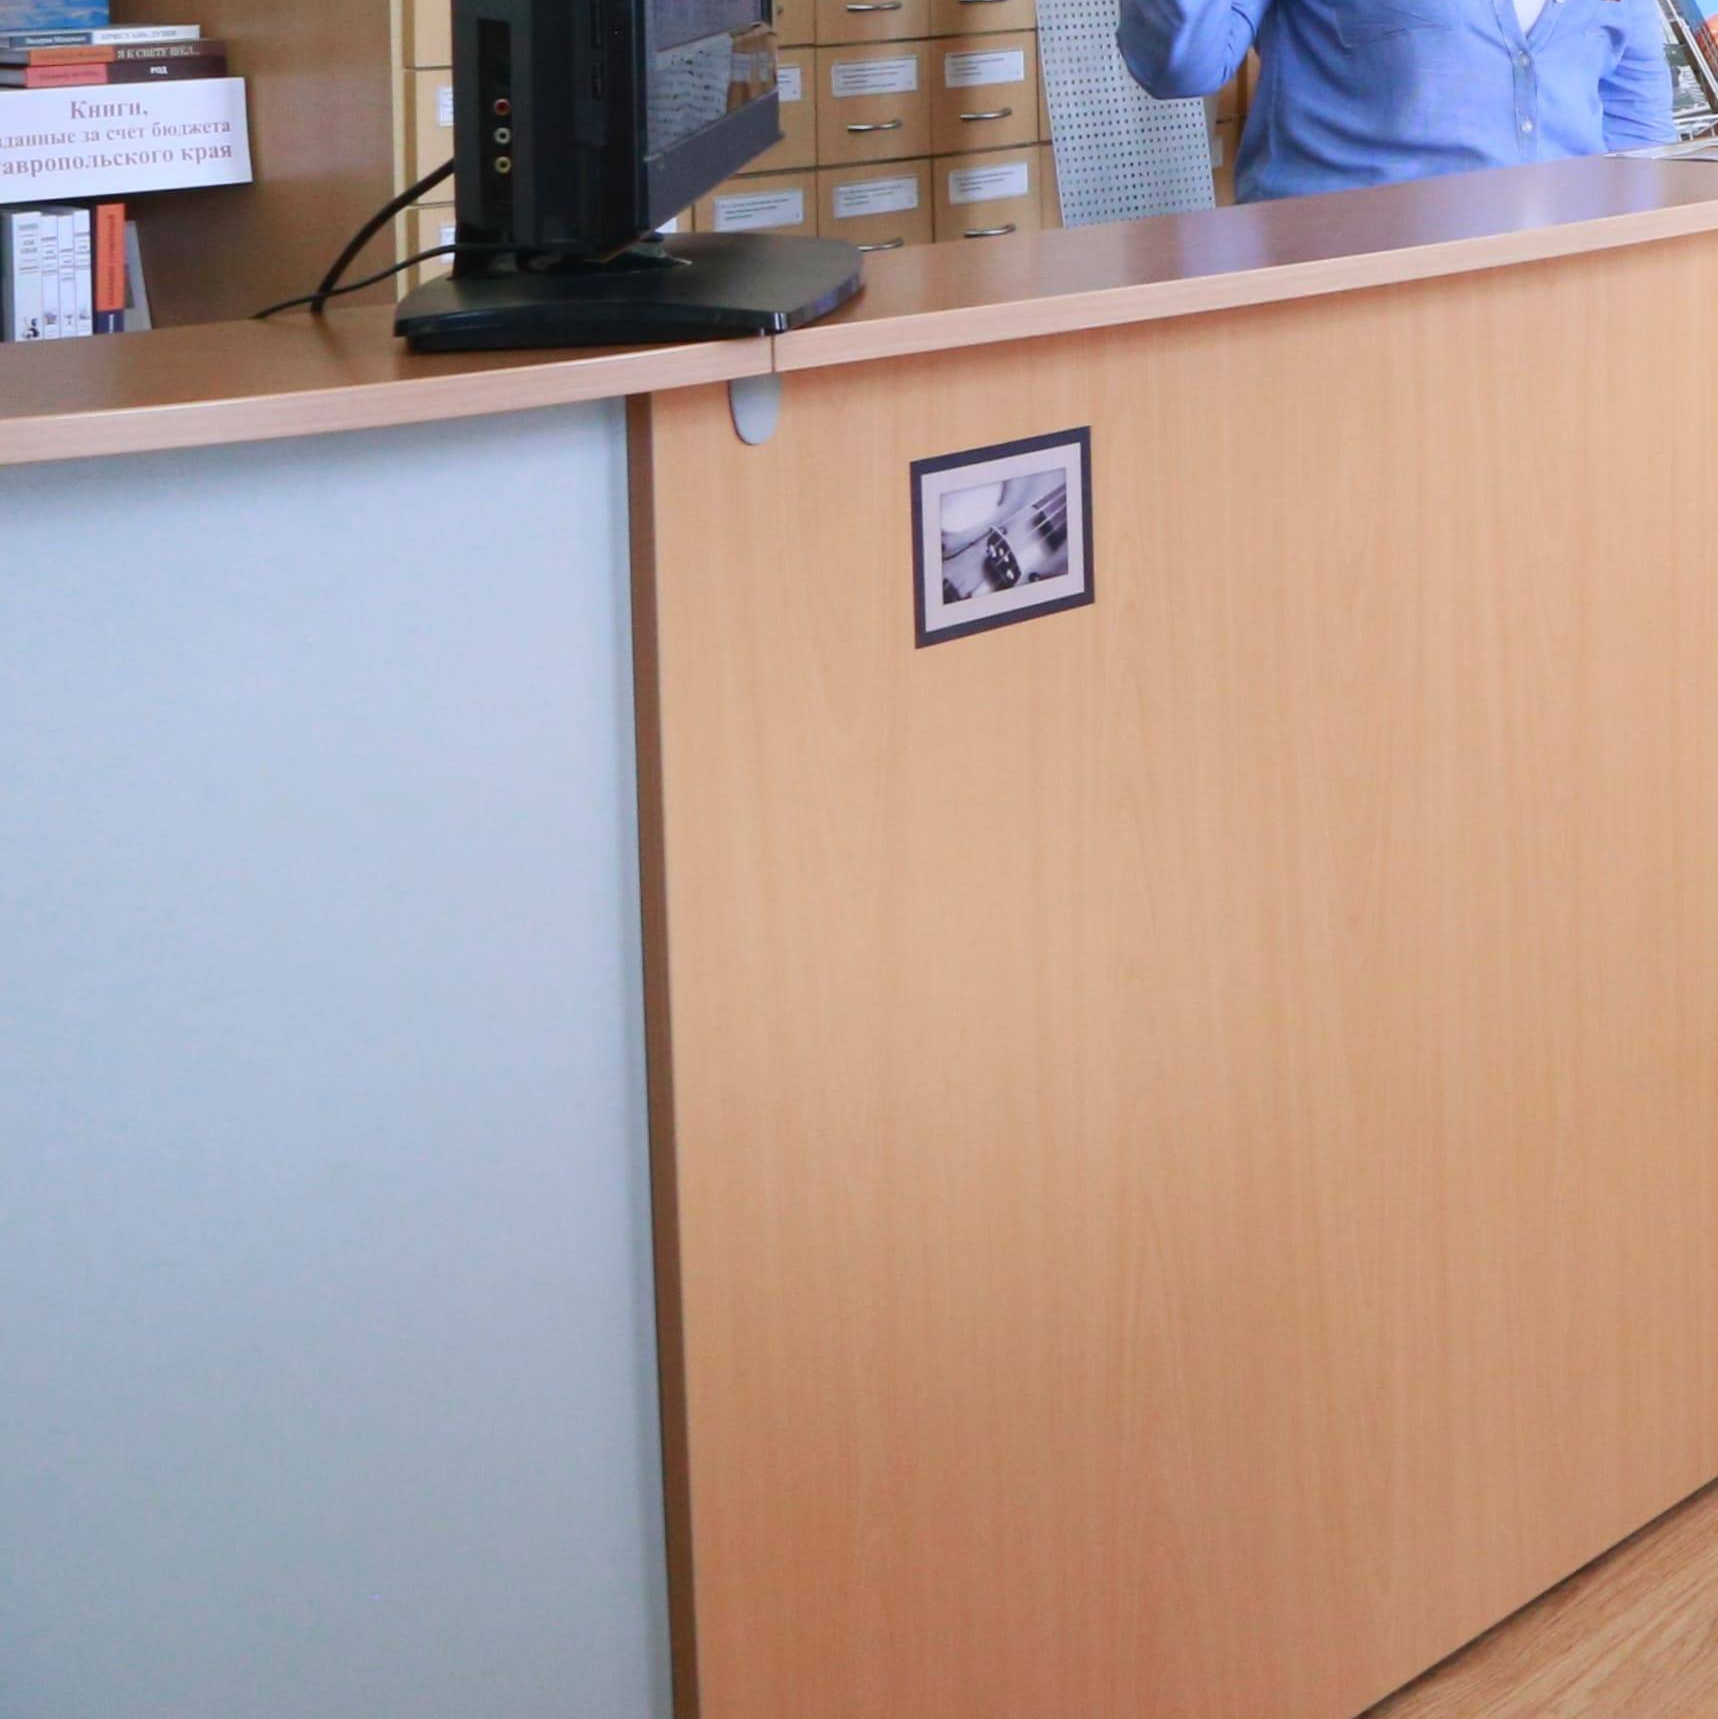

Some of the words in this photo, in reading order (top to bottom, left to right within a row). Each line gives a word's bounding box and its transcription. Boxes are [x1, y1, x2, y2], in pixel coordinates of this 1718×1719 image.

[70, 101, 149, 121] Книги,
[81, 129, 100, 143] за
[152, 120, 232, 138] бюджета
[181, 143, 233, 165] края
